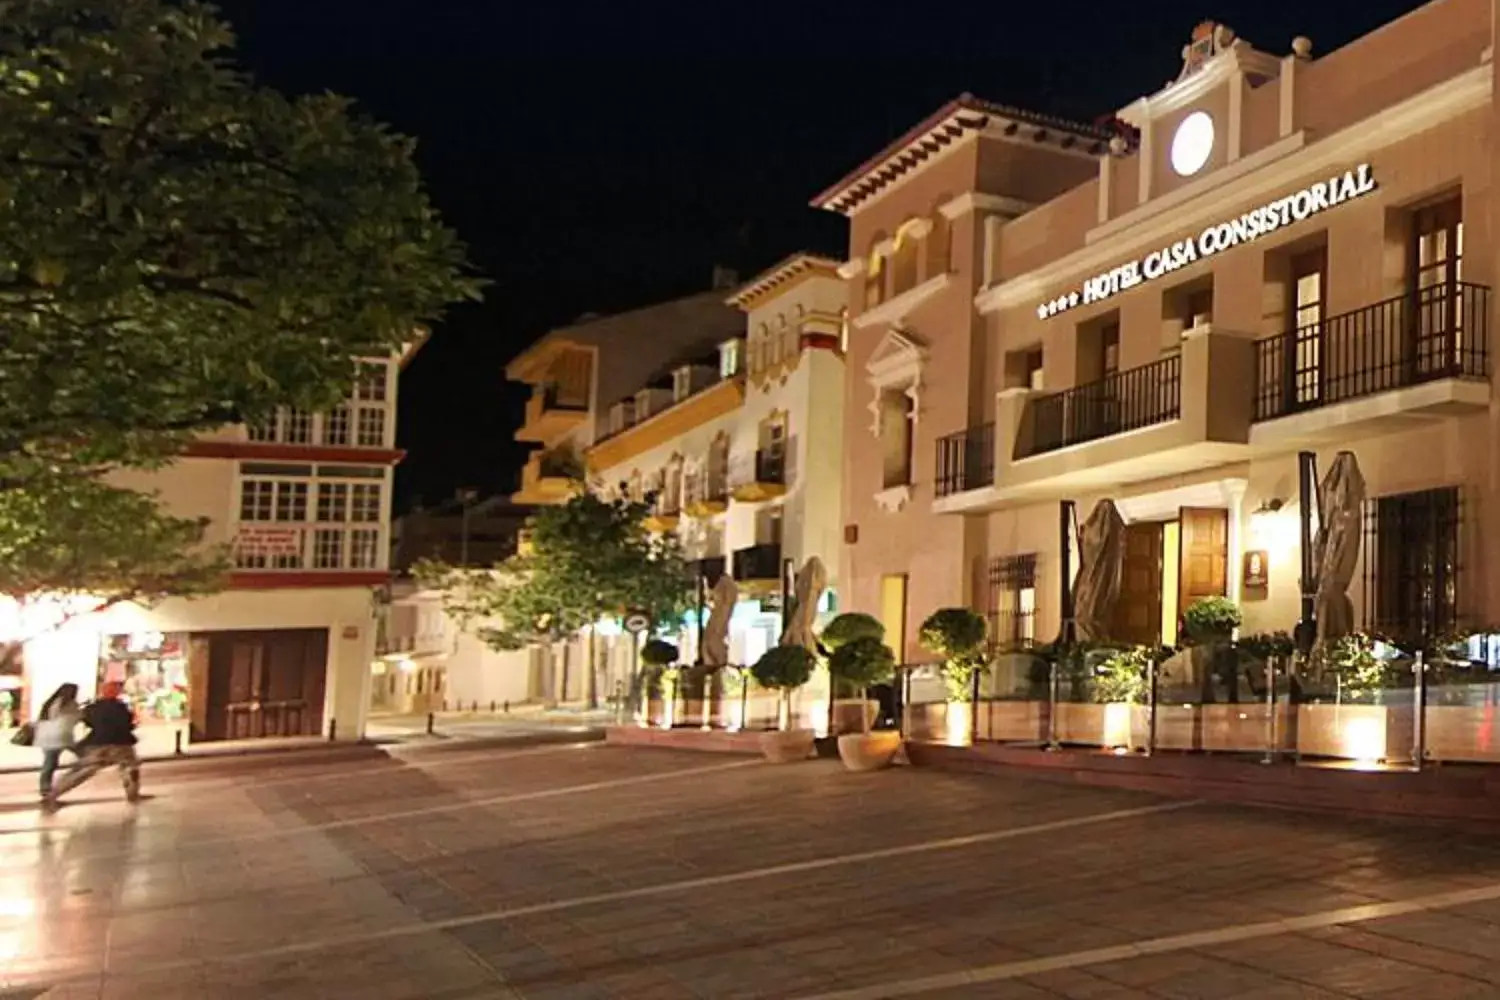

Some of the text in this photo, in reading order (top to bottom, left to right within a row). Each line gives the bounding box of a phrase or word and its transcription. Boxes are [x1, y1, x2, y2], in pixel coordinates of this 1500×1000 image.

[1083, 163, 1375, 304] HOTEL CASA CONSISTORIAL
